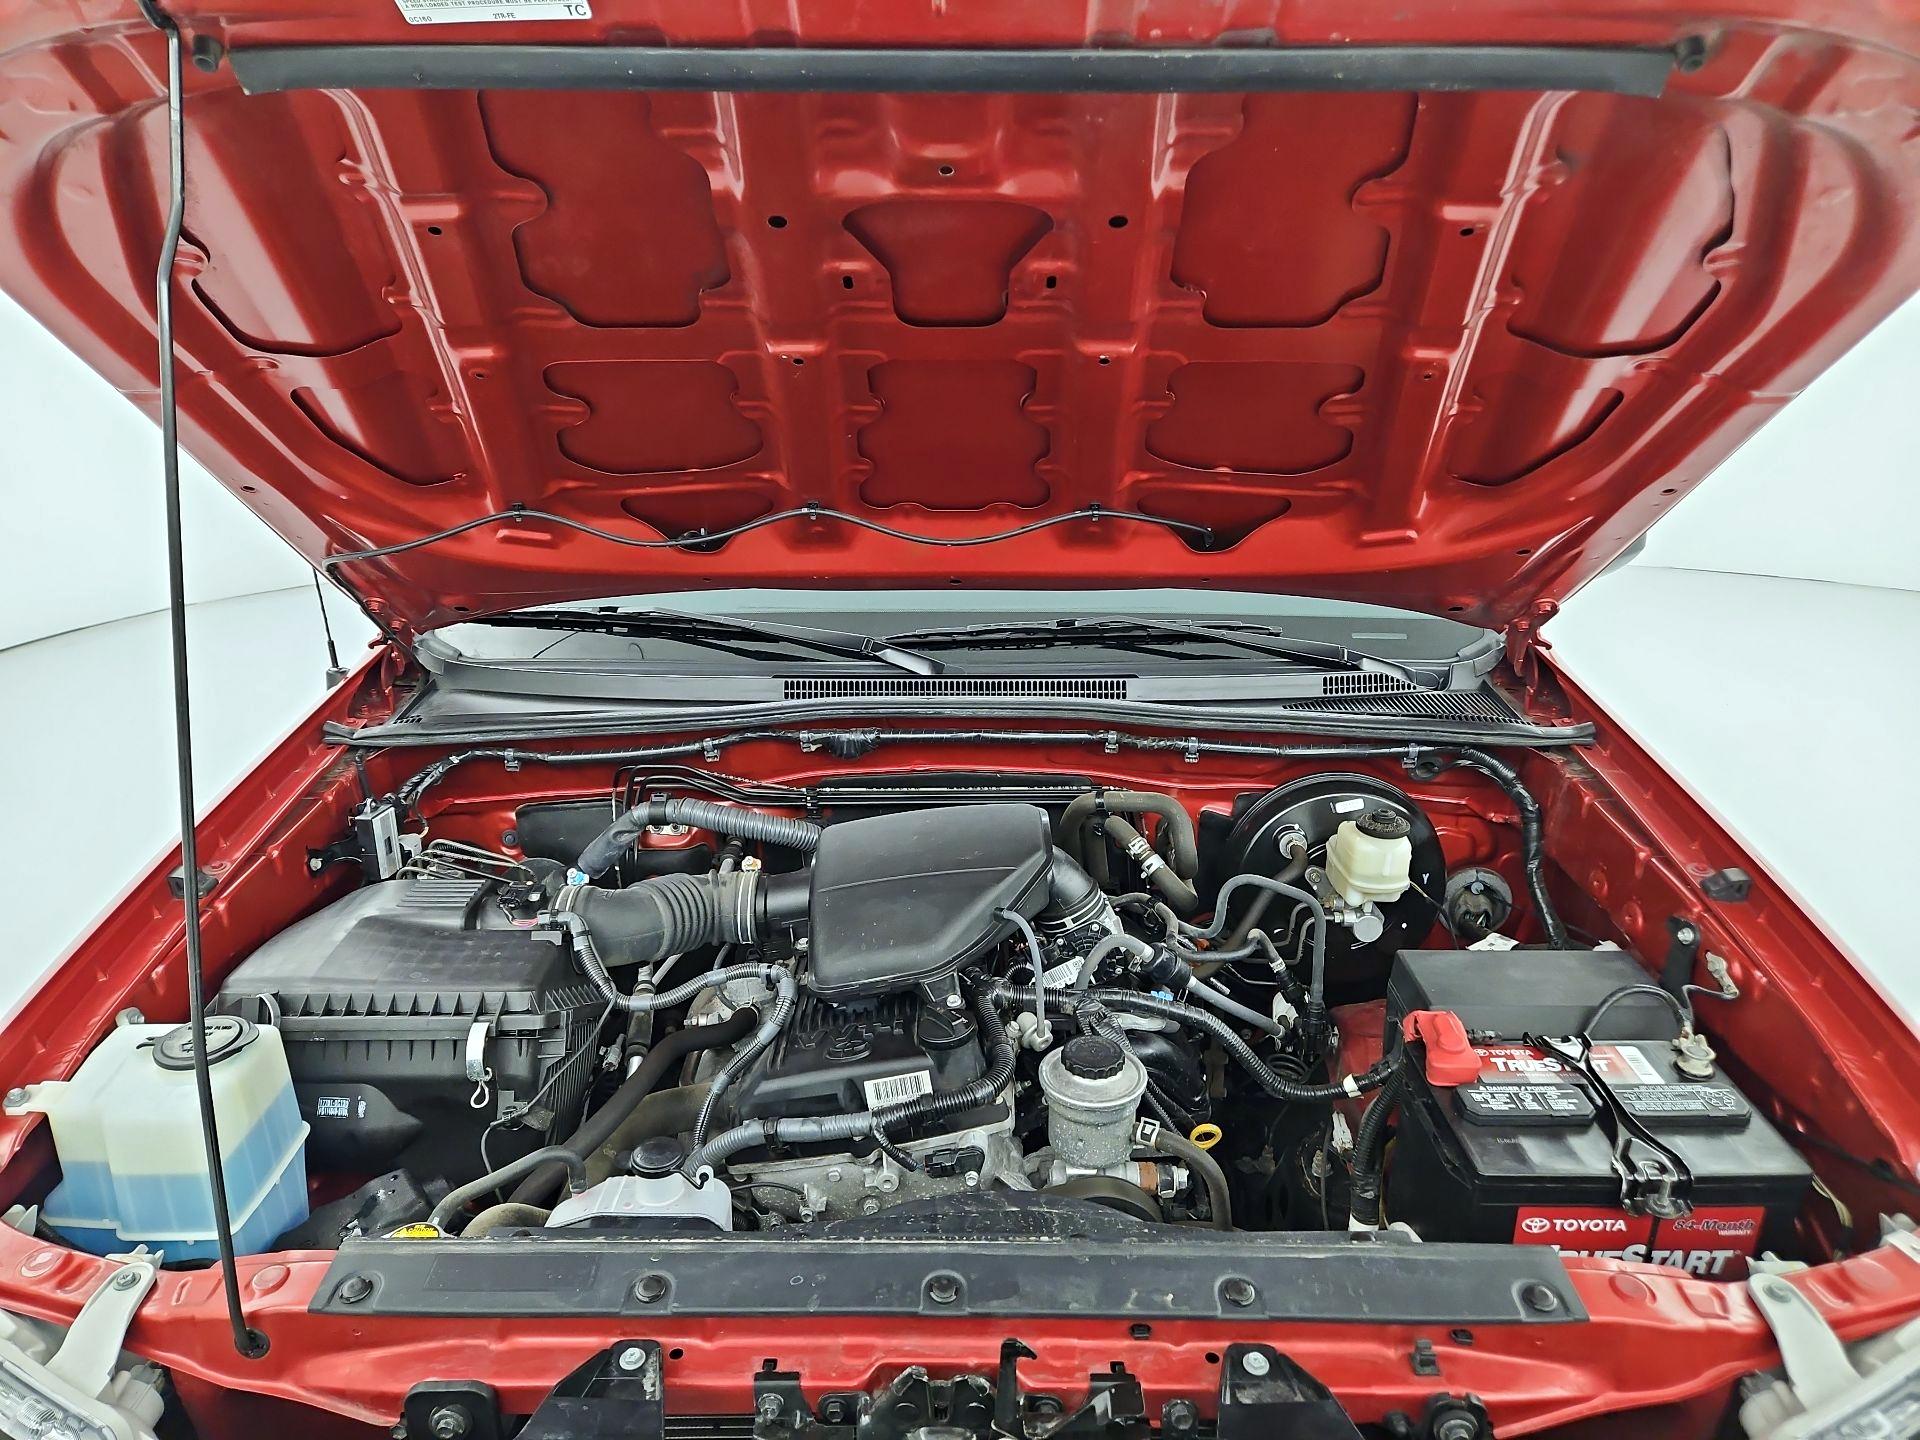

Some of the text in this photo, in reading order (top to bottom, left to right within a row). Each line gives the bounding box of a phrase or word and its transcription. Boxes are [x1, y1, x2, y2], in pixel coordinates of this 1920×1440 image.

[563, 4, 587, 16] TC
[1488, 1049, 1535, 1057] TOYOTA
[1552, 1218, 1628, 1233] TOYOTA
